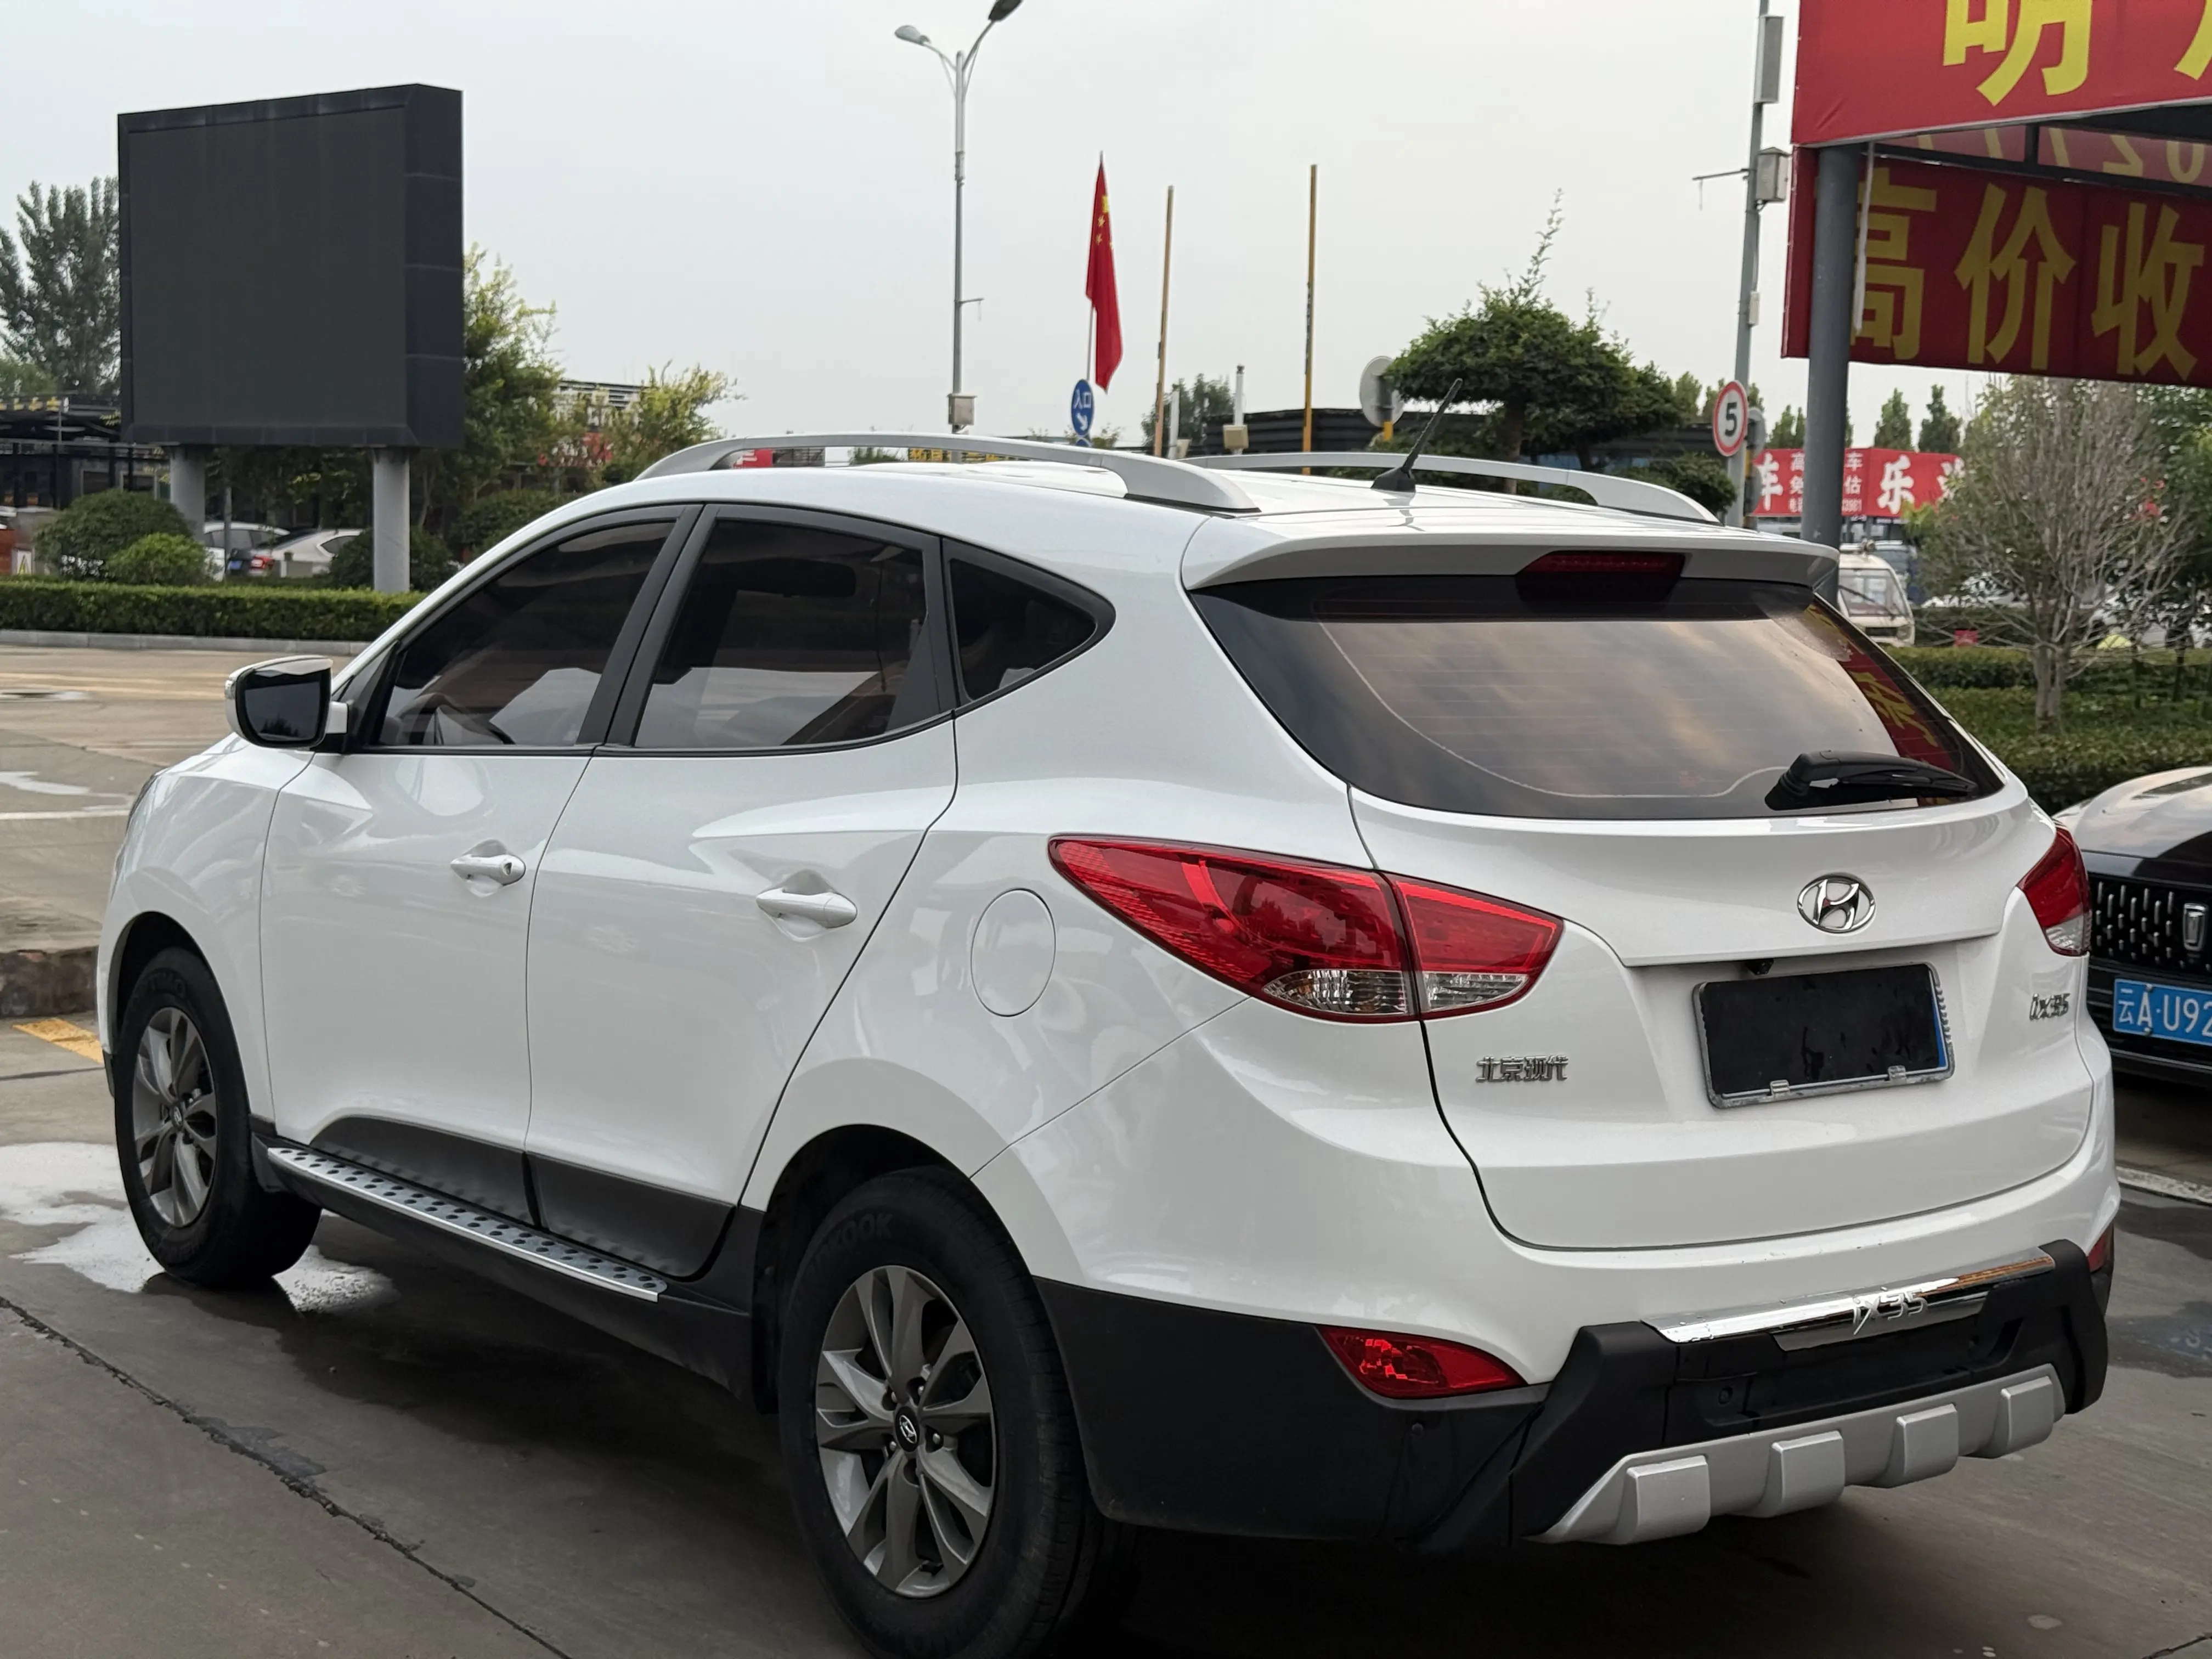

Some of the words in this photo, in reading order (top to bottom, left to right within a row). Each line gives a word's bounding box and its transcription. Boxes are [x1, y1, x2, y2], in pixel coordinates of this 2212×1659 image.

[1073, 388, 1092, 410] 入口
[1725, 402, 1737, 437] 5
[1475, 1055, 1569, 1083] 北京现代
[1853, 1288, 1928, 1335] ix35
